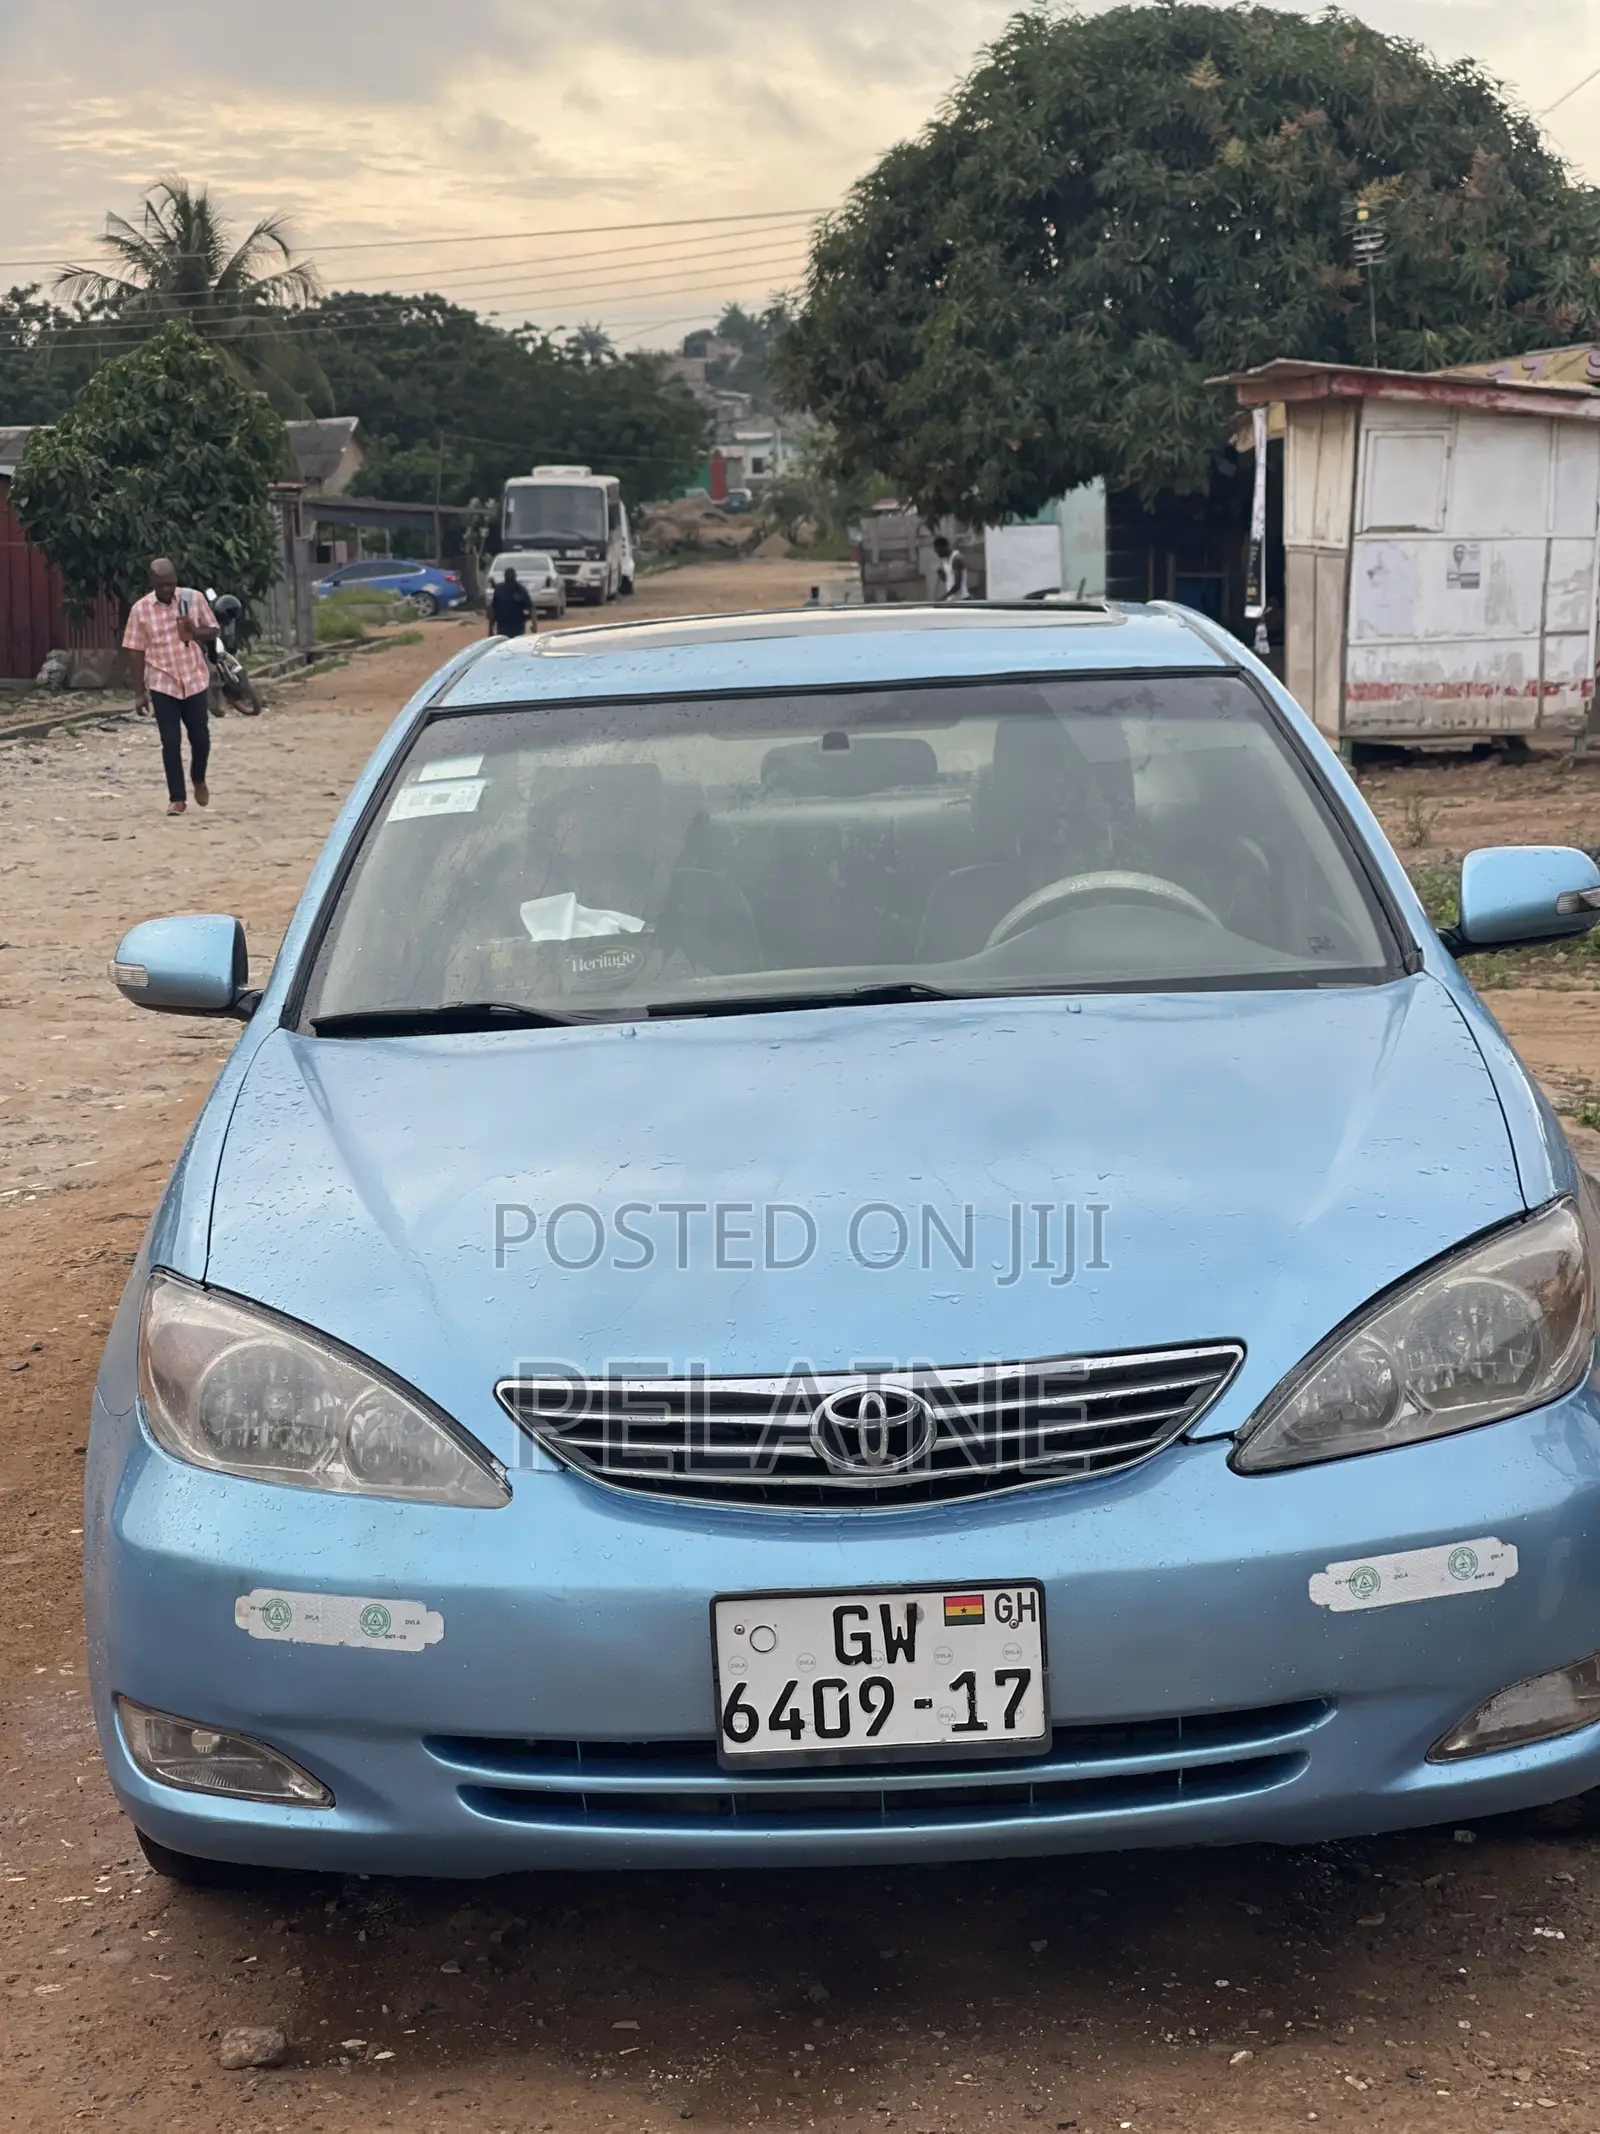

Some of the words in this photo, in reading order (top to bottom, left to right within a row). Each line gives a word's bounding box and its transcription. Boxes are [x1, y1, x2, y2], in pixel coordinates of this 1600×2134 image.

[567, 951, 635, 972] Heritage
[994, 1591, 1037, 1624] GH
[832, 1602, 918, 1666] GW
